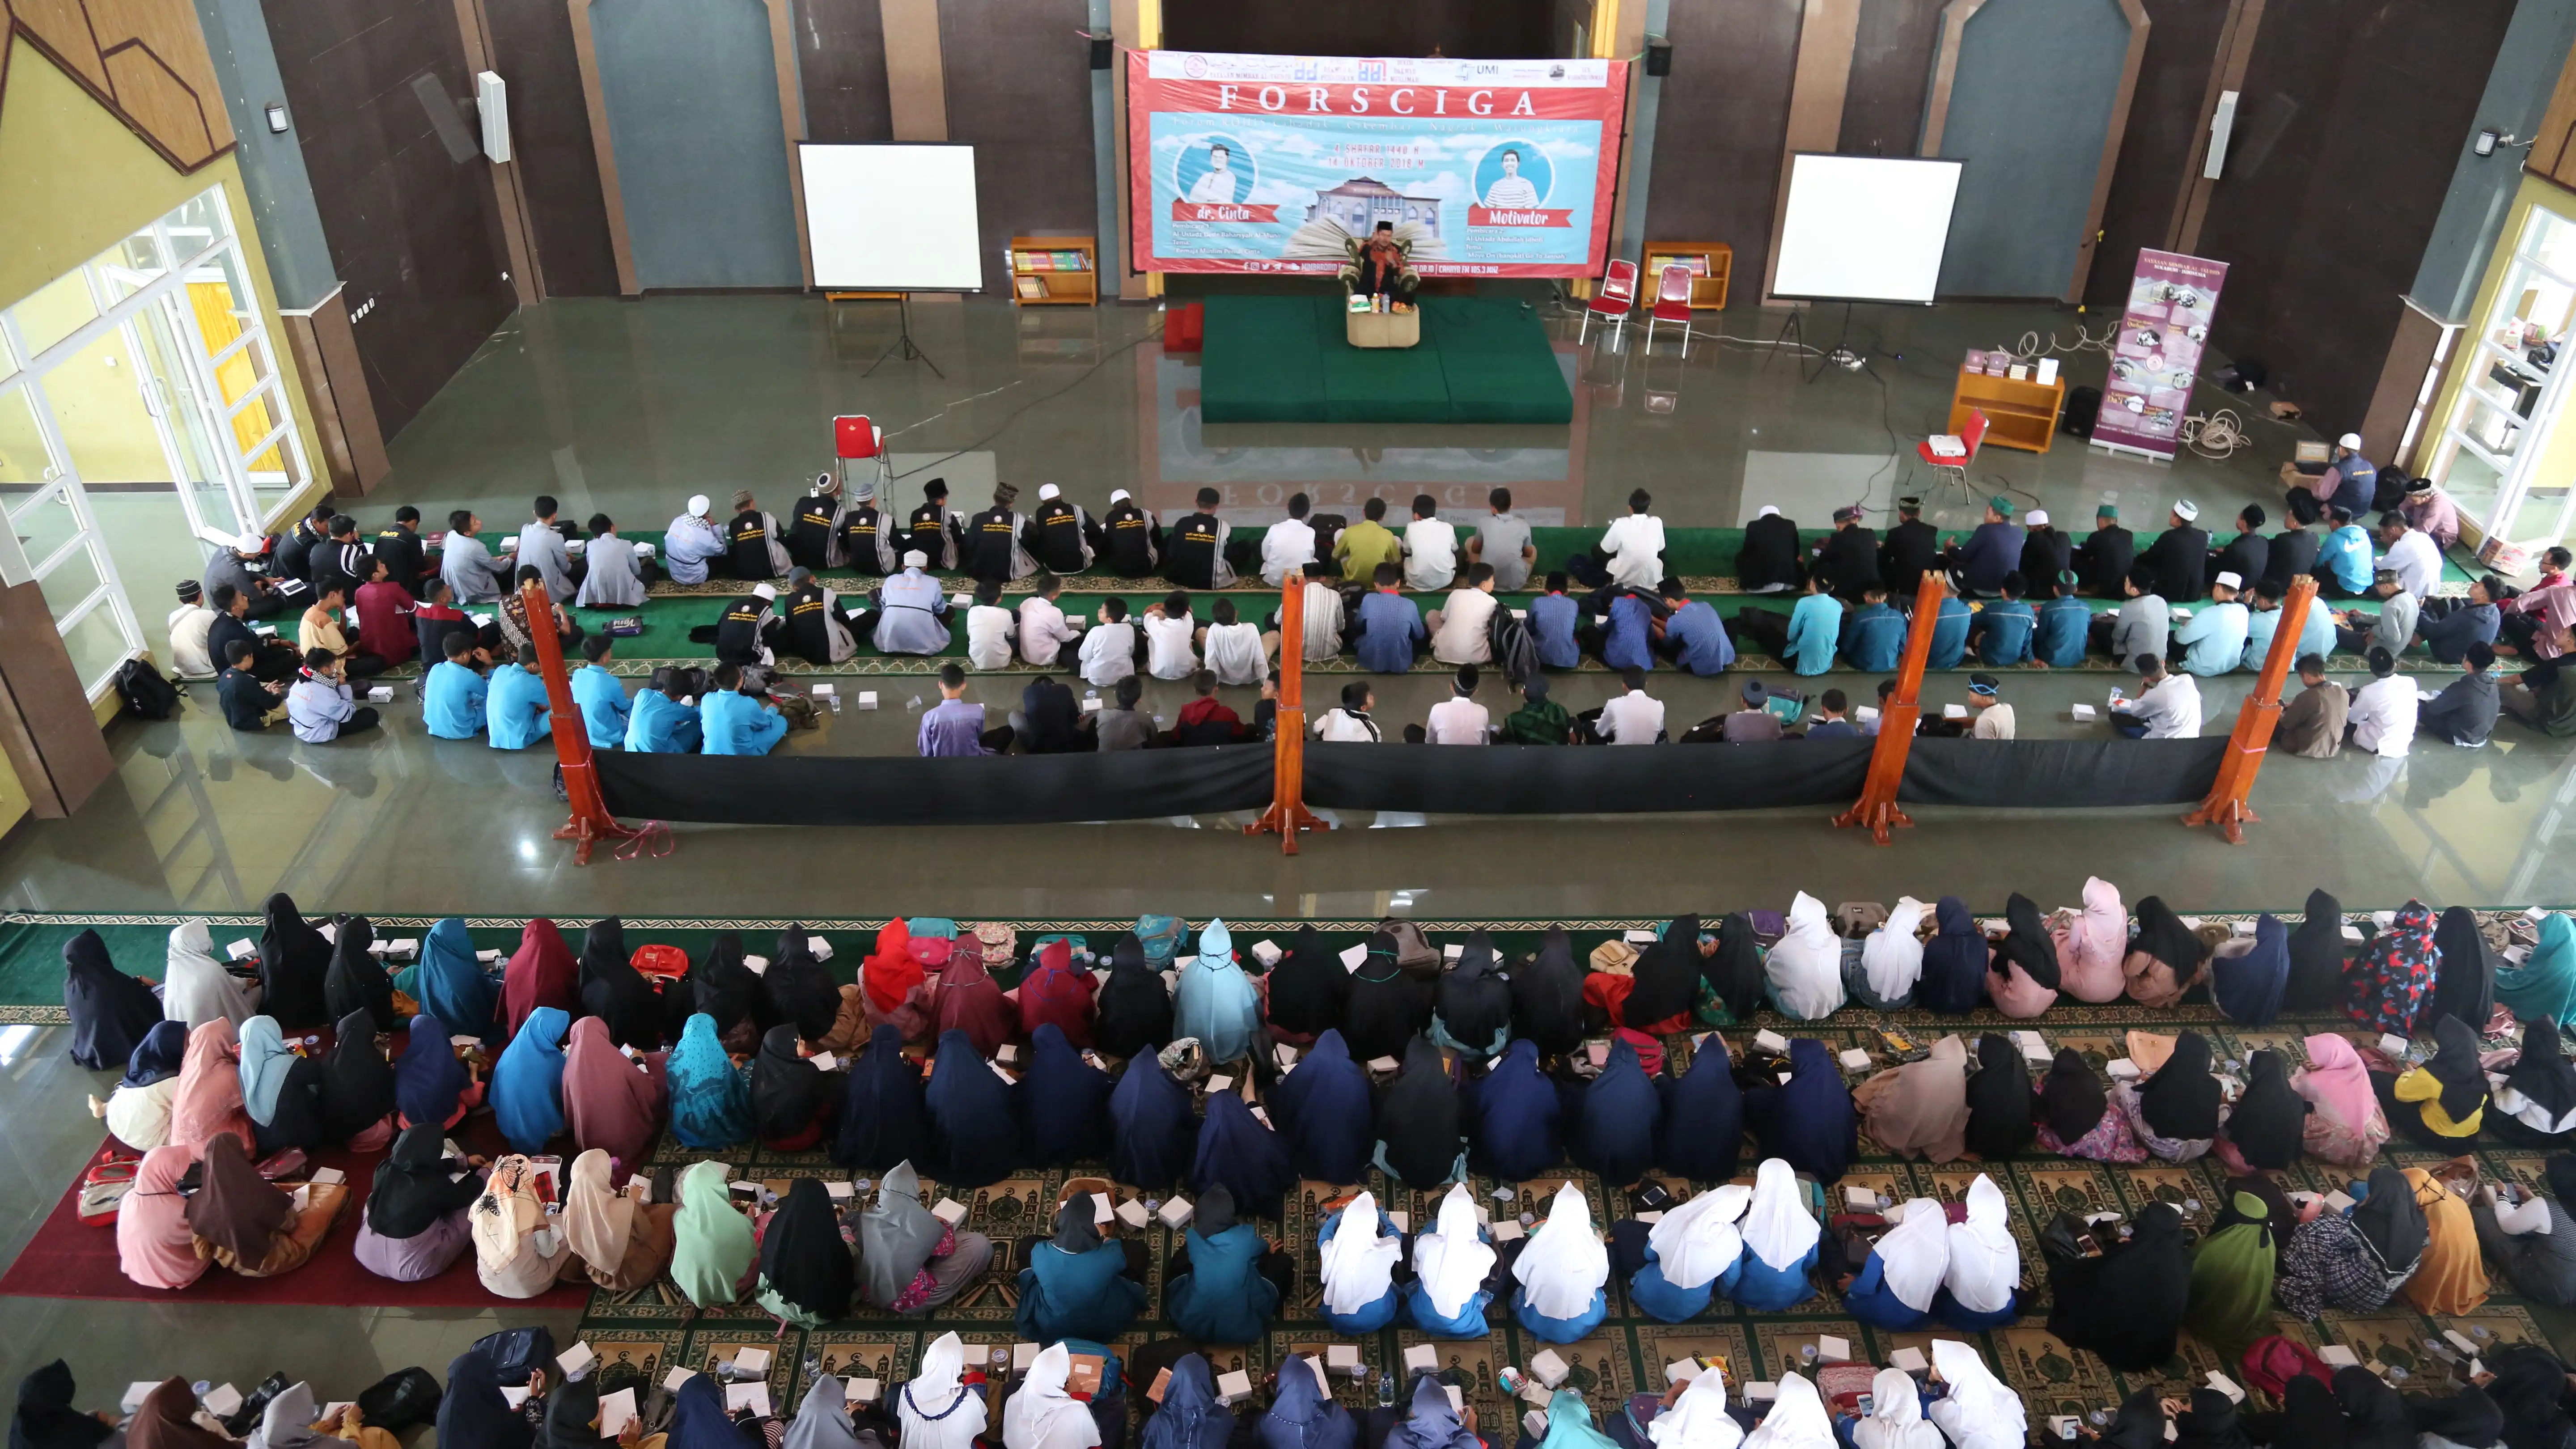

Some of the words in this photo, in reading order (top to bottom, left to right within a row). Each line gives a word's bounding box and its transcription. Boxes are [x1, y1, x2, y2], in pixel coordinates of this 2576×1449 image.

[1477, 65, 1499, 75] UMI
[1218, 84, 1536, 116] FORSCIGA
[1174, 117, 1214, 126] Forum
[1335, 144, 1339, 153] 4
[1345, 144, 1381, 154] SHAFAR
[1386, 145, 1408, 155] 1440
[1329, 157, 1338, 166] 14
[1344, 157, 1384, 168] OKTOBER
[1390, 158, 1412, 169] 2018
[1418, 160, 1424, 169] M
[1197, 206, 1215, 220] dr.
[1218, 206, 1250, 220] Cinta
[1489, 210, 1548, 225] Motivator
[1438, 265, 1461, 273] CAHAYA
[1462, 265, 1470, 274] FM
